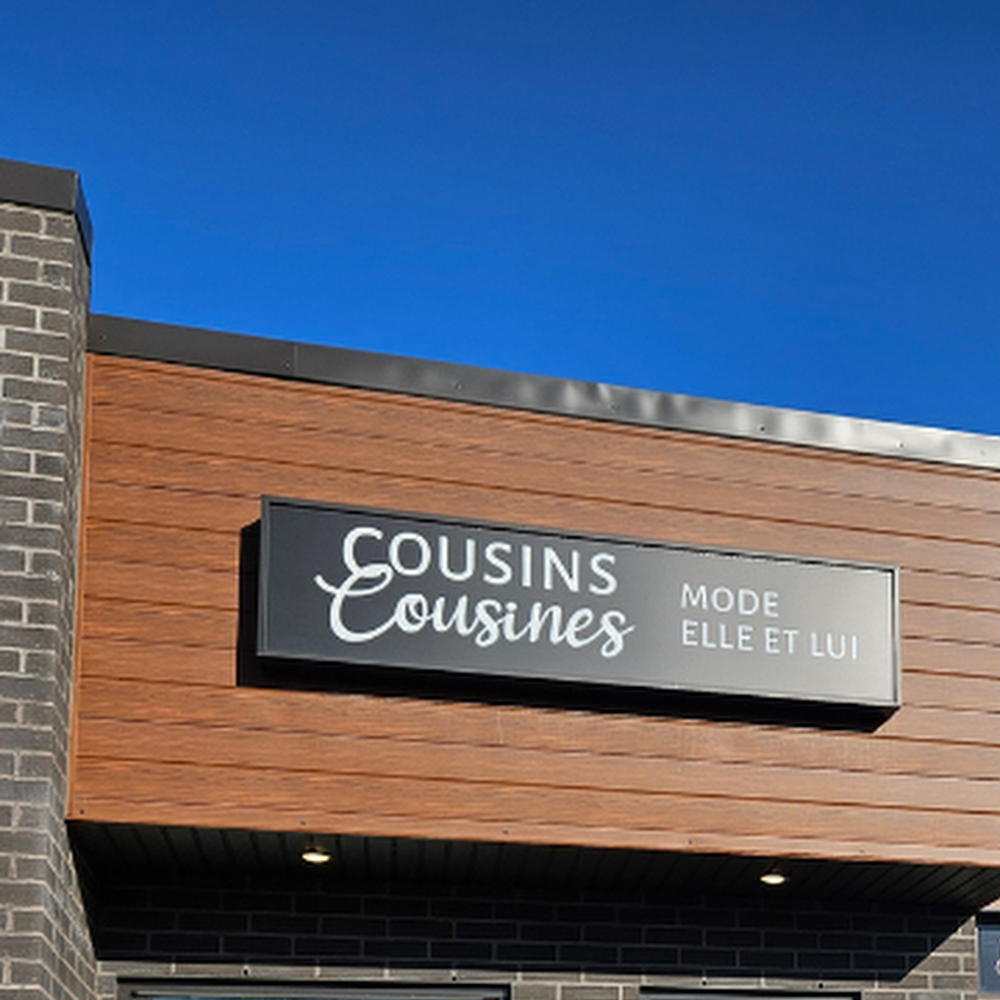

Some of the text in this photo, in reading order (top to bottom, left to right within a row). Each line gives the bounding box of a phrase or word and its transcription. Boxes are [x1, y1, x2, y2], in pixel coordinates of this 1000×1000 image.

[343, 526, 618, 596] COUSINS
[313, 563, 636, 658] Cousines
[680, 582, 780, 618] MODE
[682, 619, 858, 661] ELLE ET LUI
